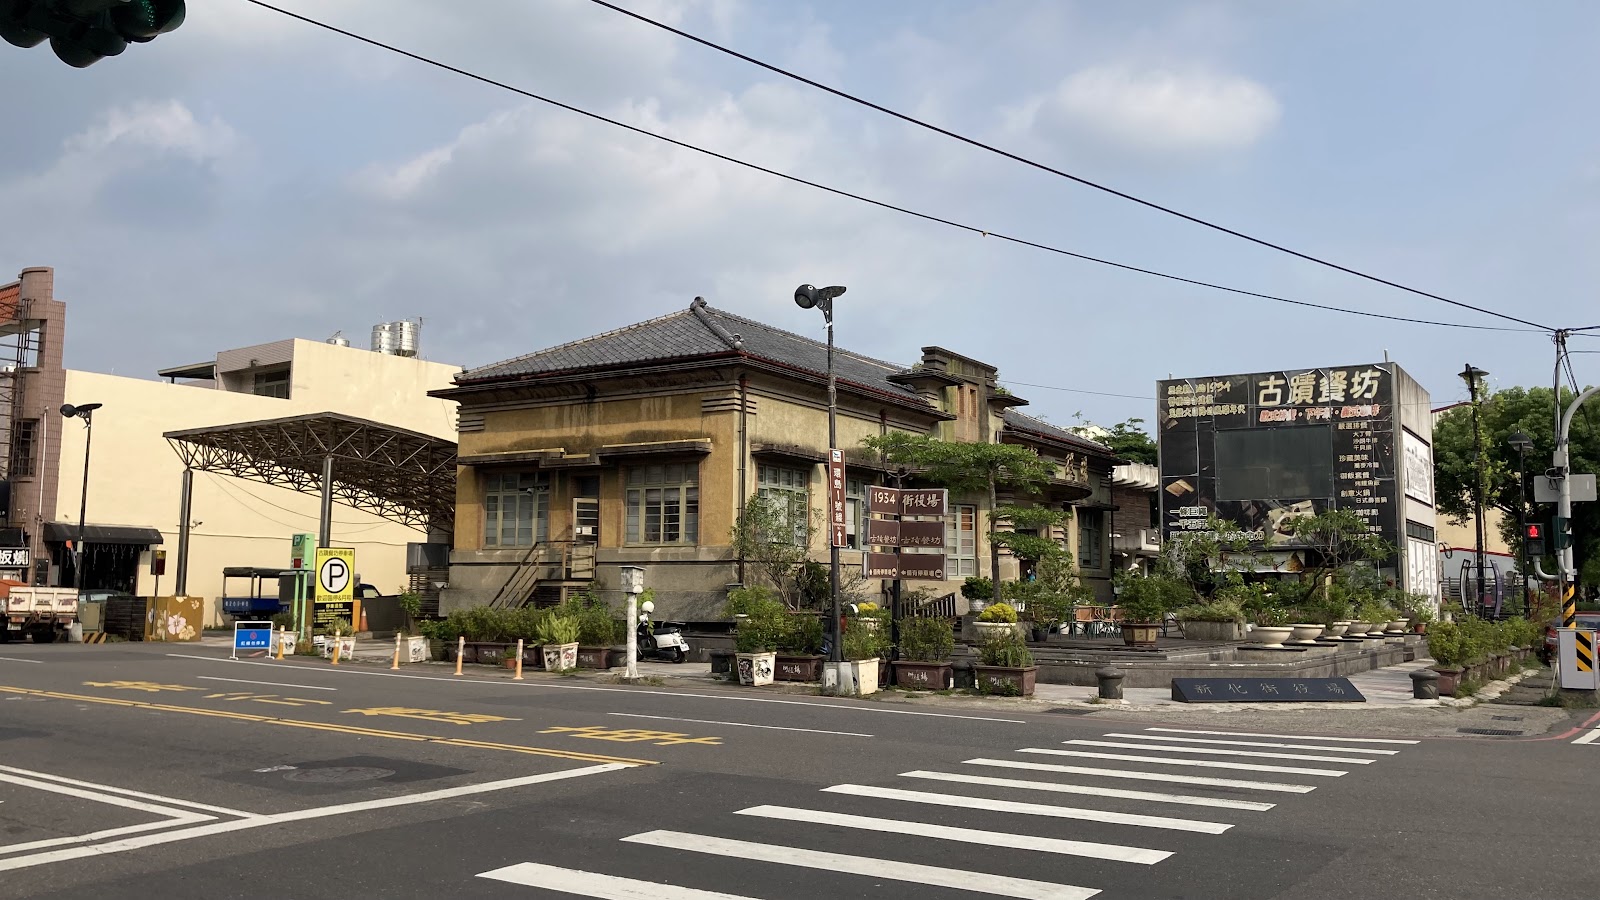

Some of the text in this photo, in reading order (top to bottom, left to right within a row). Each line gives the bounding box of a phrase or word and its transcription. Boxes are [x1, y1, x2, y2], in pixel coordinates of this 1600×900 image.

[1259, 369, 1381, 406] 古蹟餐坊
[1339, 454, 1369, 462] 珍藏美味
[833, 468, 843, 522] 環島1號線
[874, 491, 896, 505] 1934
[1341, 489, 1370, 497] 創意火鍋
[902, 493, 941, 514] 街役場
[0, 550, 28, 565] 板燒
[329, 563, 345, 588] P
